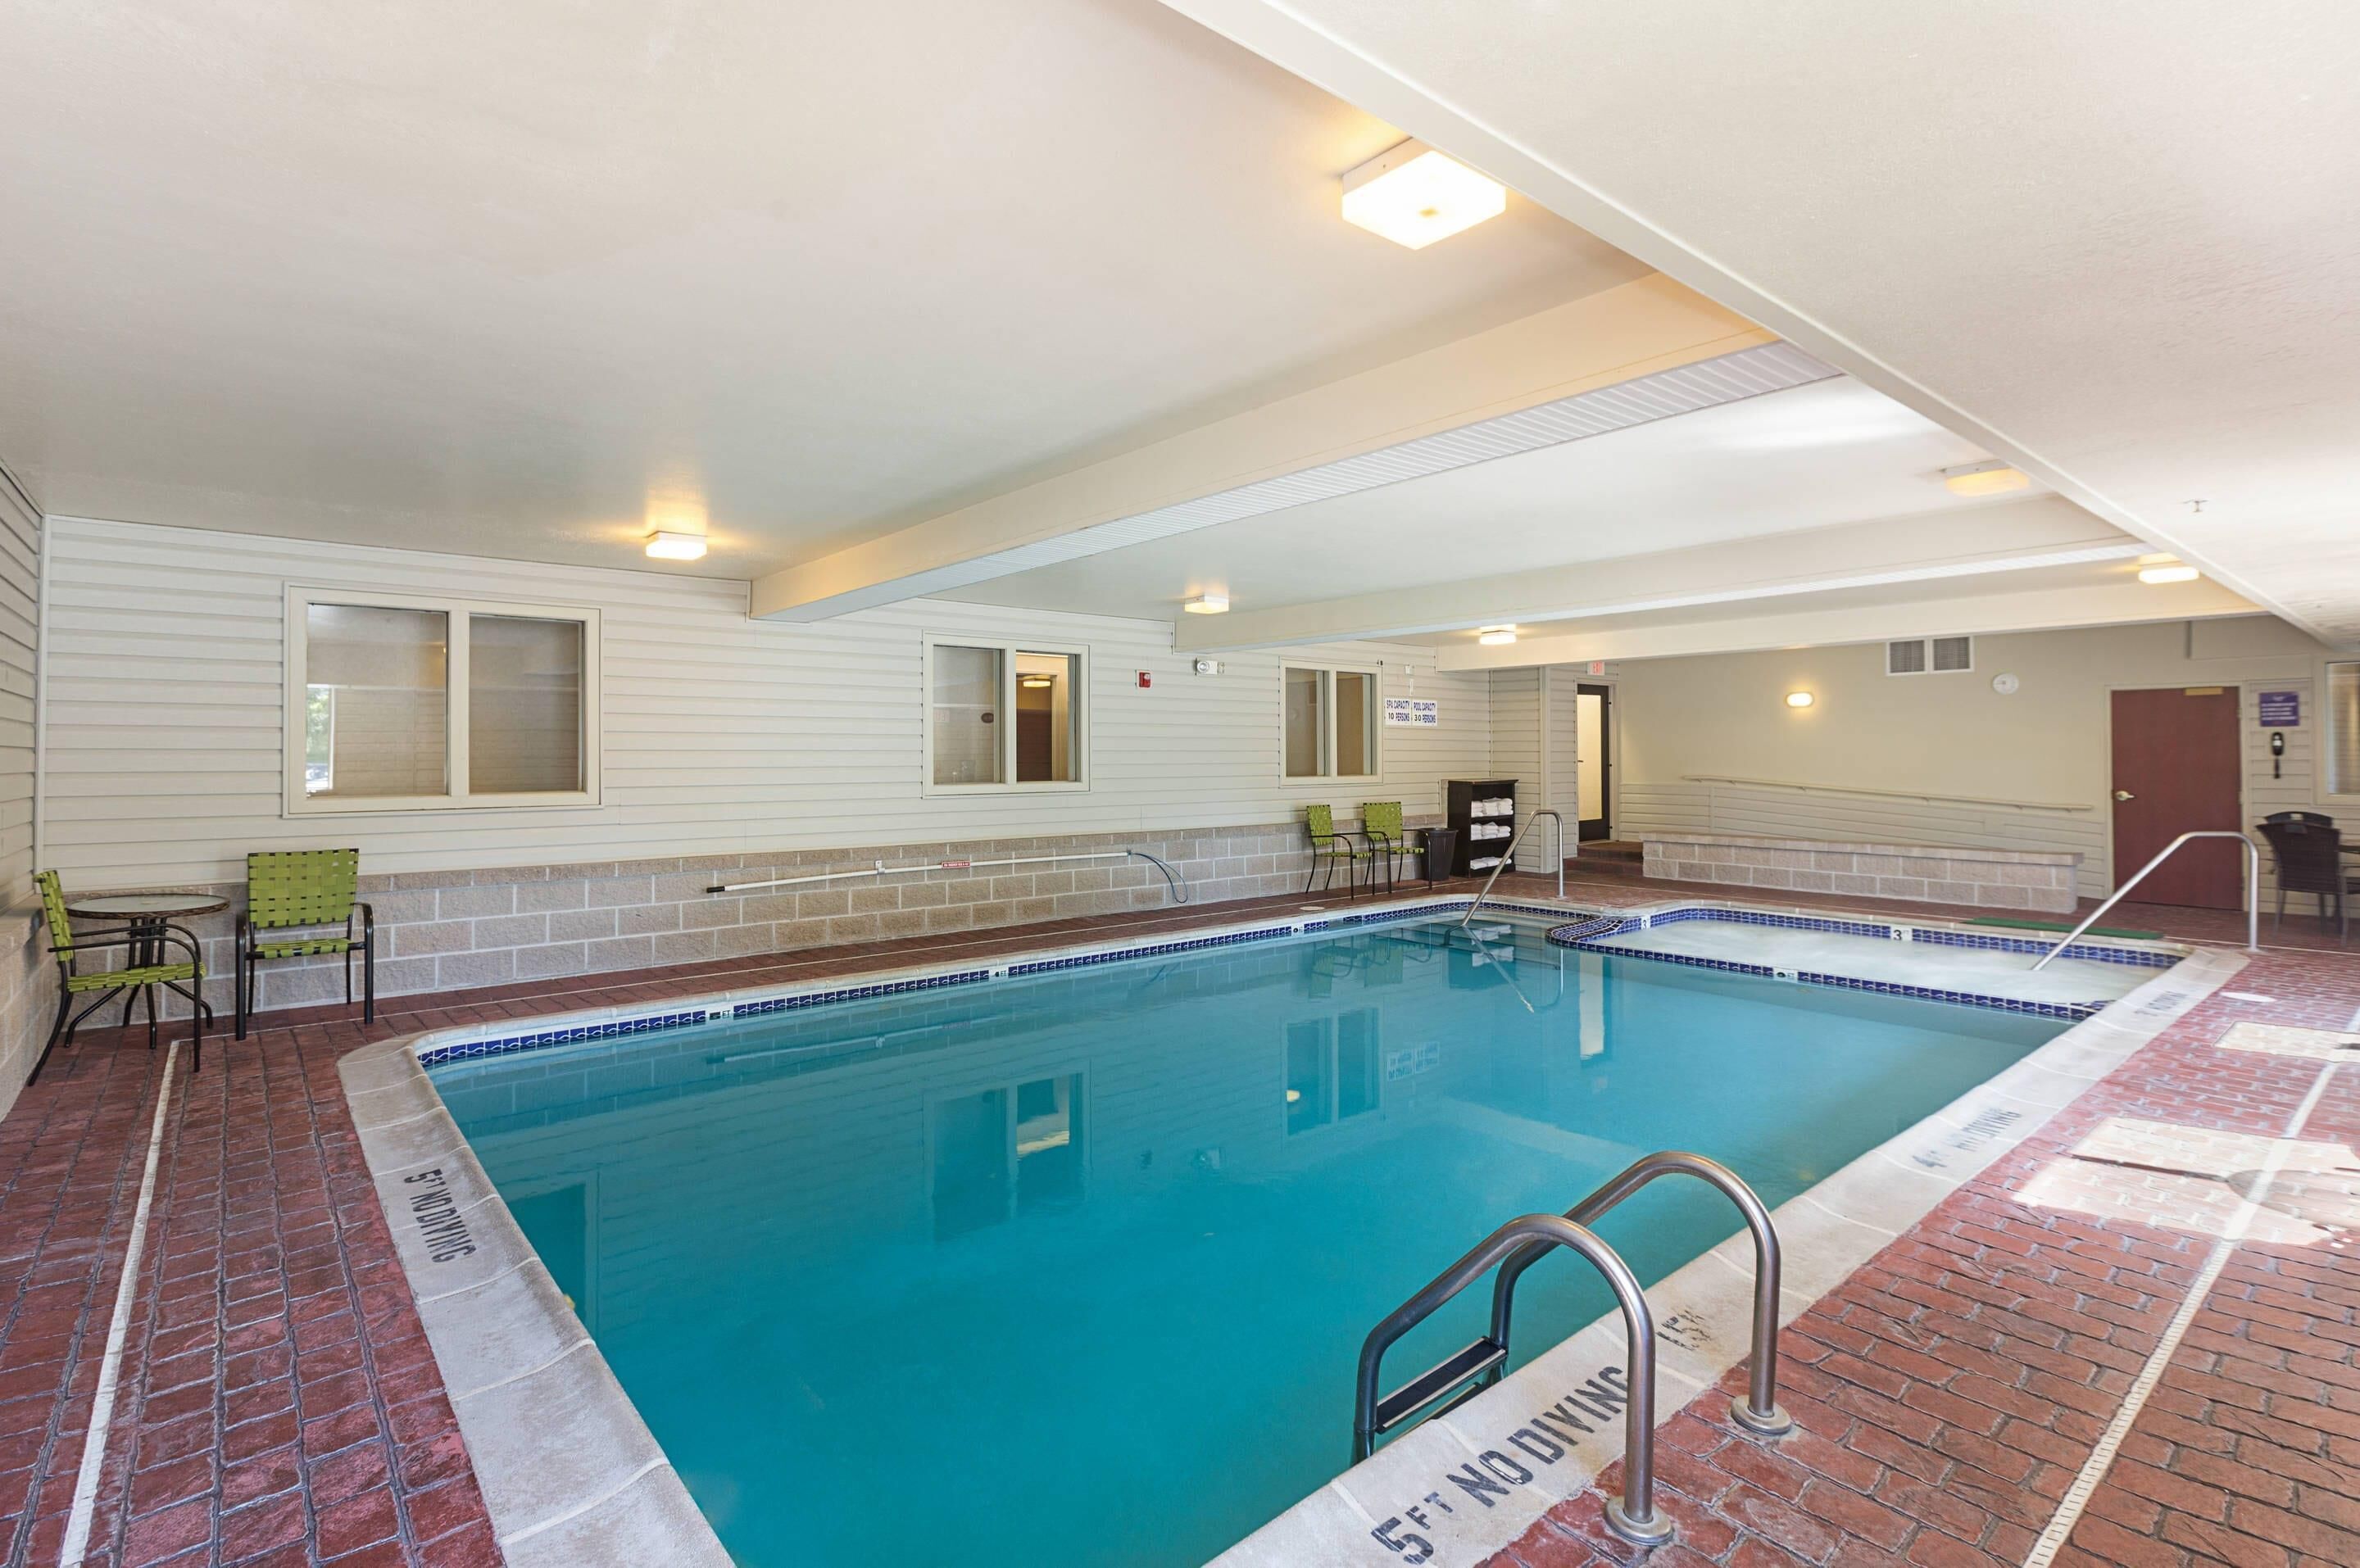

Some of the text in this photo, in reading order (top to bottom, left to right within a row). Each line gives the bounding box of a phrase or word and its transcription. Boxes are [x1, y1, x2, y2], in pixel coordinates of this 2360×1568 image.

[1394, 700, 1410, 709] CAPACITY
[1414, 702, 1436, 711] POOL CAPACITY
[1388, 712, 1410, 722] 10 PERSONS
[1422, 714, 1436, 723] PERSONS
[1894, 929, 1902, 940] 3
[409, 1188, 453, 1212] NO
[415, 1207, 477, 1262] DIVING
[1446, 1449, 1534, 1508] NO
